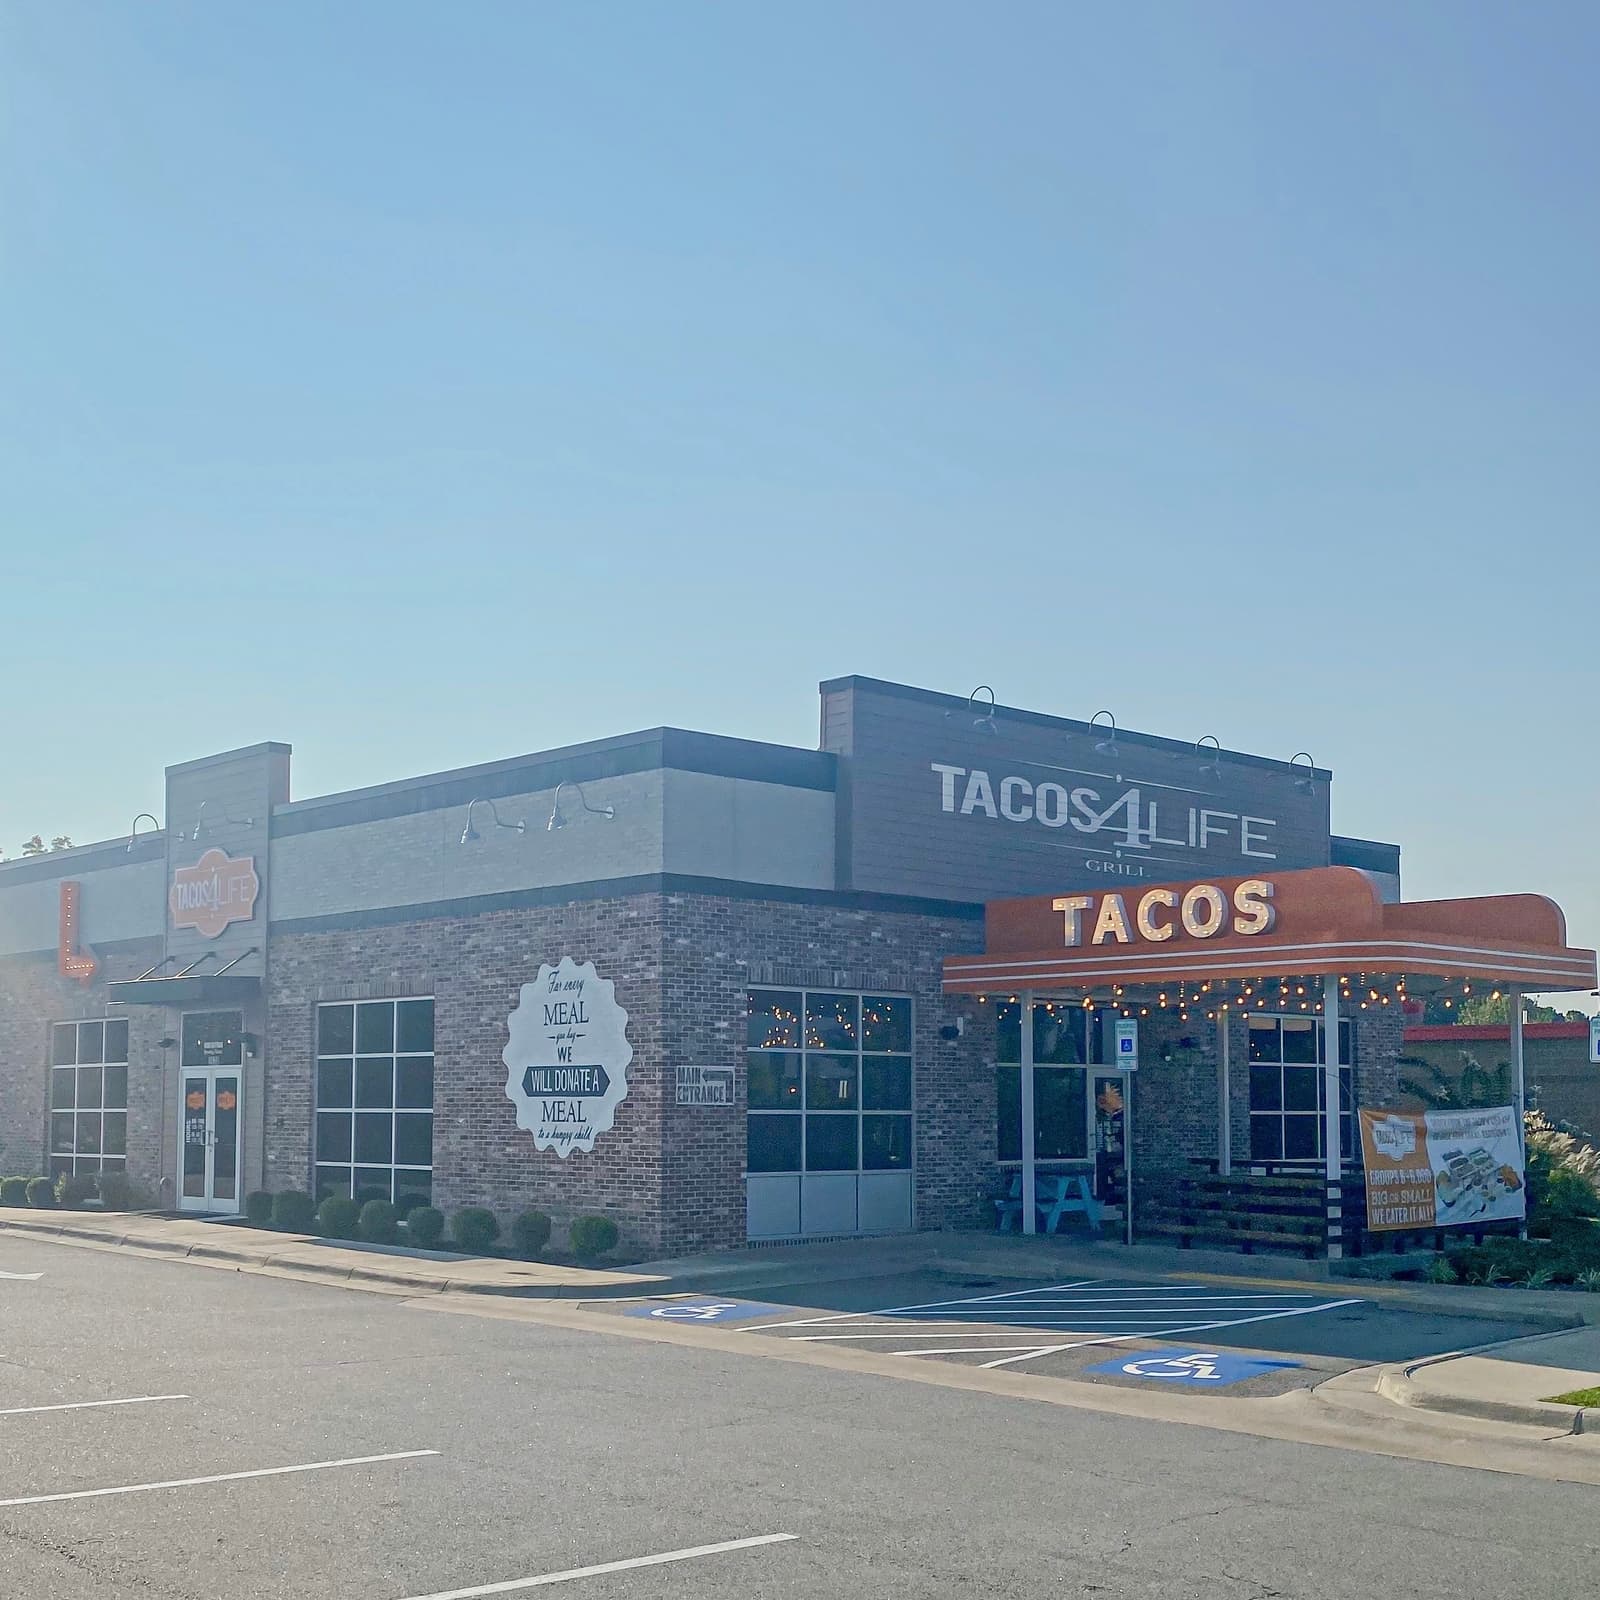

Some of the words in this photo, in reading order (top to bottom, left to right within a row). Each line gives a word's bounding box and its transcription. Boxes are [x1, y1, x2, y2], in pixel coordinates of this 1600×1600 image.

[930, 762, 1100, 834] TACOS
[1148, 801, 1277, 860] LIFE
[1052, 880, 1275, 947] TACOS
[543, 1000, 589, 1026] MEAL
[557, 1046, 572, 1062] WE
[531, 1070, 552, 1092] WILL
[555, 1068, 591, 1093] DONATE
[592, 1068, 600, 1092] A
[678, 1067, 701, 1084] MAIN
[541, 1100, 587, 1122] MEAL
[1371, 1191, 1388, 1205] BIG
[1401, 1189, 1432, 1204] SMALL
[1372, 1208, 1385, 1224] WE
[1385, 1207, 1408, 1224] CATER
